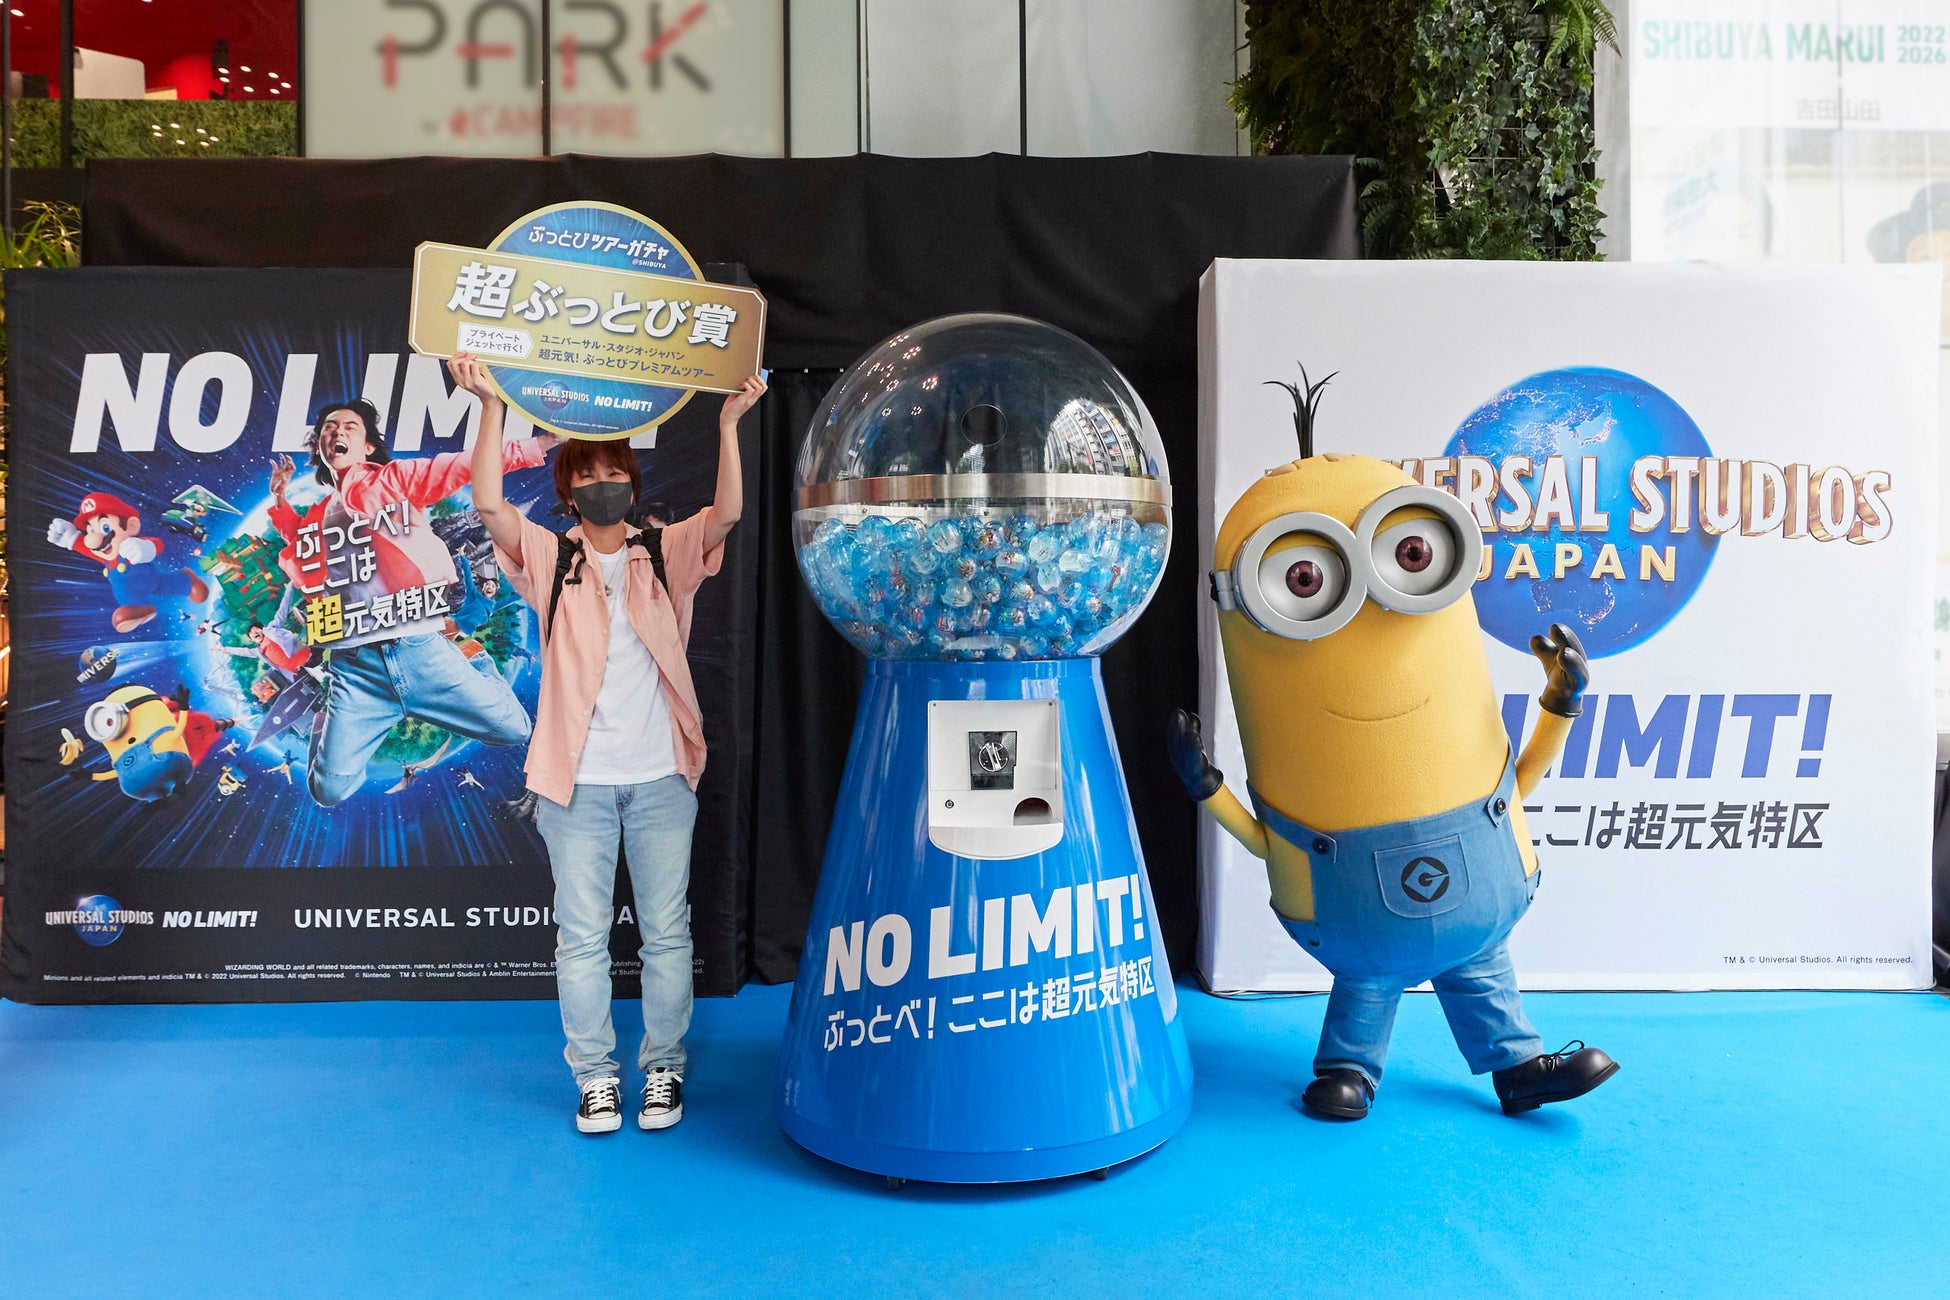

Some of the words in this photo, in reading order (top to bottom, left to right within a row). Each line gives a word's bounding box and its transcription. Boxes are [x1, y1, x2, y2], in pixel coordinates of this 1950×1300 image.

[376, 0, 712, 89] PARK
[1643, 20, 1773, 60] SHIBUYA
[1786, 23, 1884, 63] MARUI
[1897, 25, 1946, 43] 2022
[1897, 46, 1946, 64] 2026
[528, 226, 669, 260] ぶっとびツアーガチャ
[632, 259, 667, 269] @SHIBUYA
[447, 262, 737, 349] 超ぶっとび賞
[70, 352, 254, 453] NO
[522, 386, 559, 398] UNIVERSAL
[561, 390, 590, 402] STUDIOS
[594, 395, 613, 408] NO
[614, 397, 653, 412] LIMIT!
[1630, 456, 1894, 545] STUDIOS
[295, 499, 411, 560] ぶっとべ!
[299, 546, 377, 594] ここは
[306, 579, 450, 646] 超元気特区
[45, 910, 106, 926] UNIVERSAL
[108, 910, 154, 925] STUDIOS
[162, 910, 193, 928] NO
[194, 910, 258, 928] LIMIT!
[294, 908, 455, 928] UNIVERSAL
[466, 907, 557, 927] STUDI
[823, 913, 912, 996] NO
[928, 873, 1145, 980] LIMIT!
[44, 974, 69, 982] Minions
[118, 974, 146, 982] elements
[1759, 956, 1797, 964] Universal
[1800, 956, 1833, 964] Studios.
[1836, 956, 1848, 964] All
[1850, 956, 1873, 966] rights
[1875, 956, 1914, 964] reserved.
[824, 996, 936, 1052] ぶっとべ!
[948, 955, 1155, 1033] ここは超元気特区
